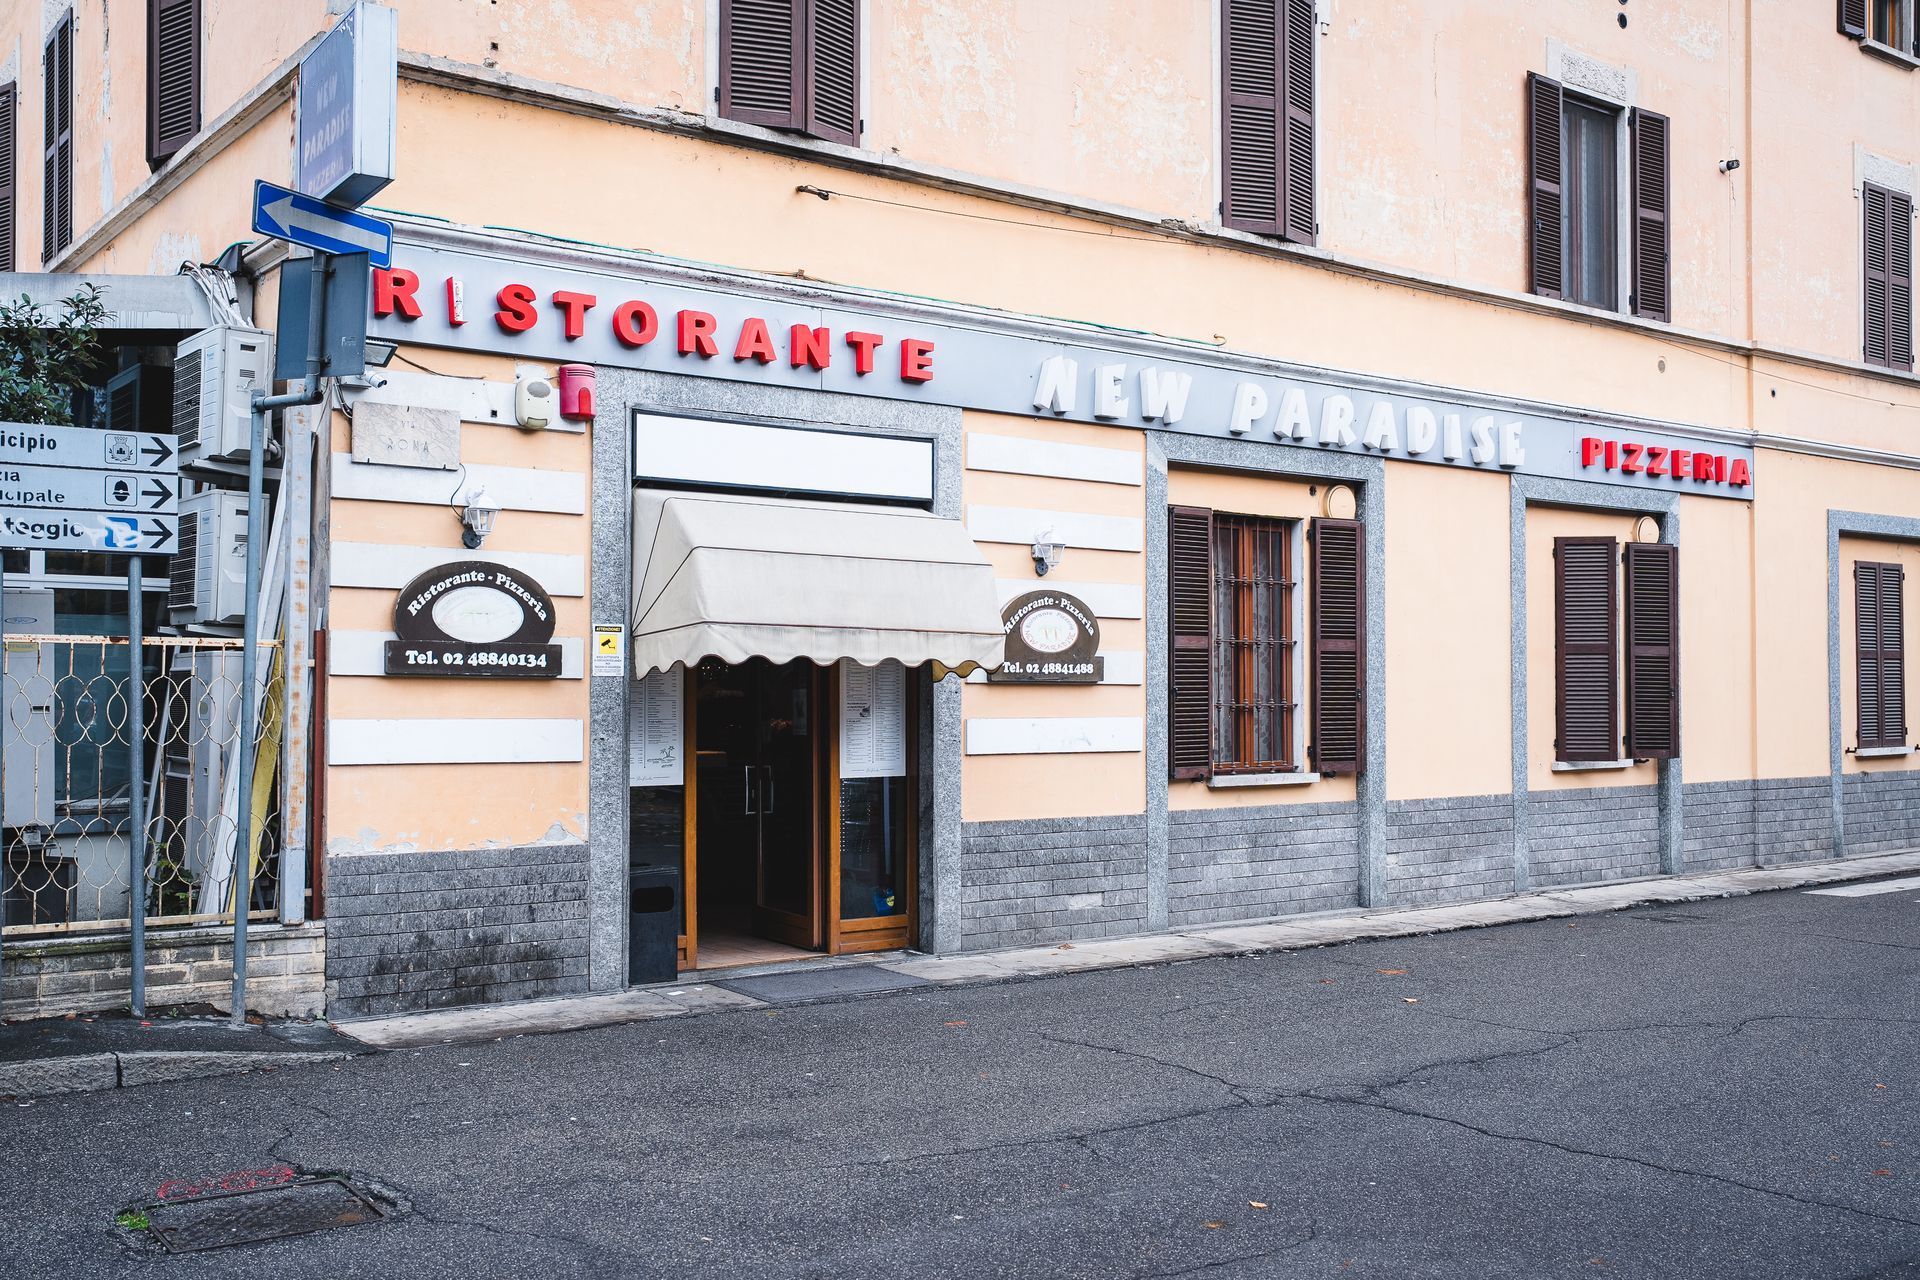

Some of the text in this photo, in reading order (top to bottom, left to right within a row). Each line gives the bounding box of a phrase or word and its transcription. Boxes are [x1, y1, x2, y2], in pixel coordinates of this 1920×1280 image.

[316, 71, 338, 115] NEW
[304, 103, 351, 168] PARADISE
[308, 156, 344, 195] PIZZERIA
[373, 267, 1751, 487] RISTORANTE NEW PARADISE PIZZERIA
[0, 430, 57, 453] icipio
[0, 471, 20, 482] ia
[0, 517, 84, 540] teggio
[406, 570, 486, 617] Ristorante
[496, 572, 548, 622] Pizzeria
[1004, 596, 1054, 635] Ristorante
[1060, 597, 1095, 637] Pizzeria
[405, 650, 547, 668] Tel. 02 48840134
[1003, 661, 1094, 675] Tel. 02 48841488
